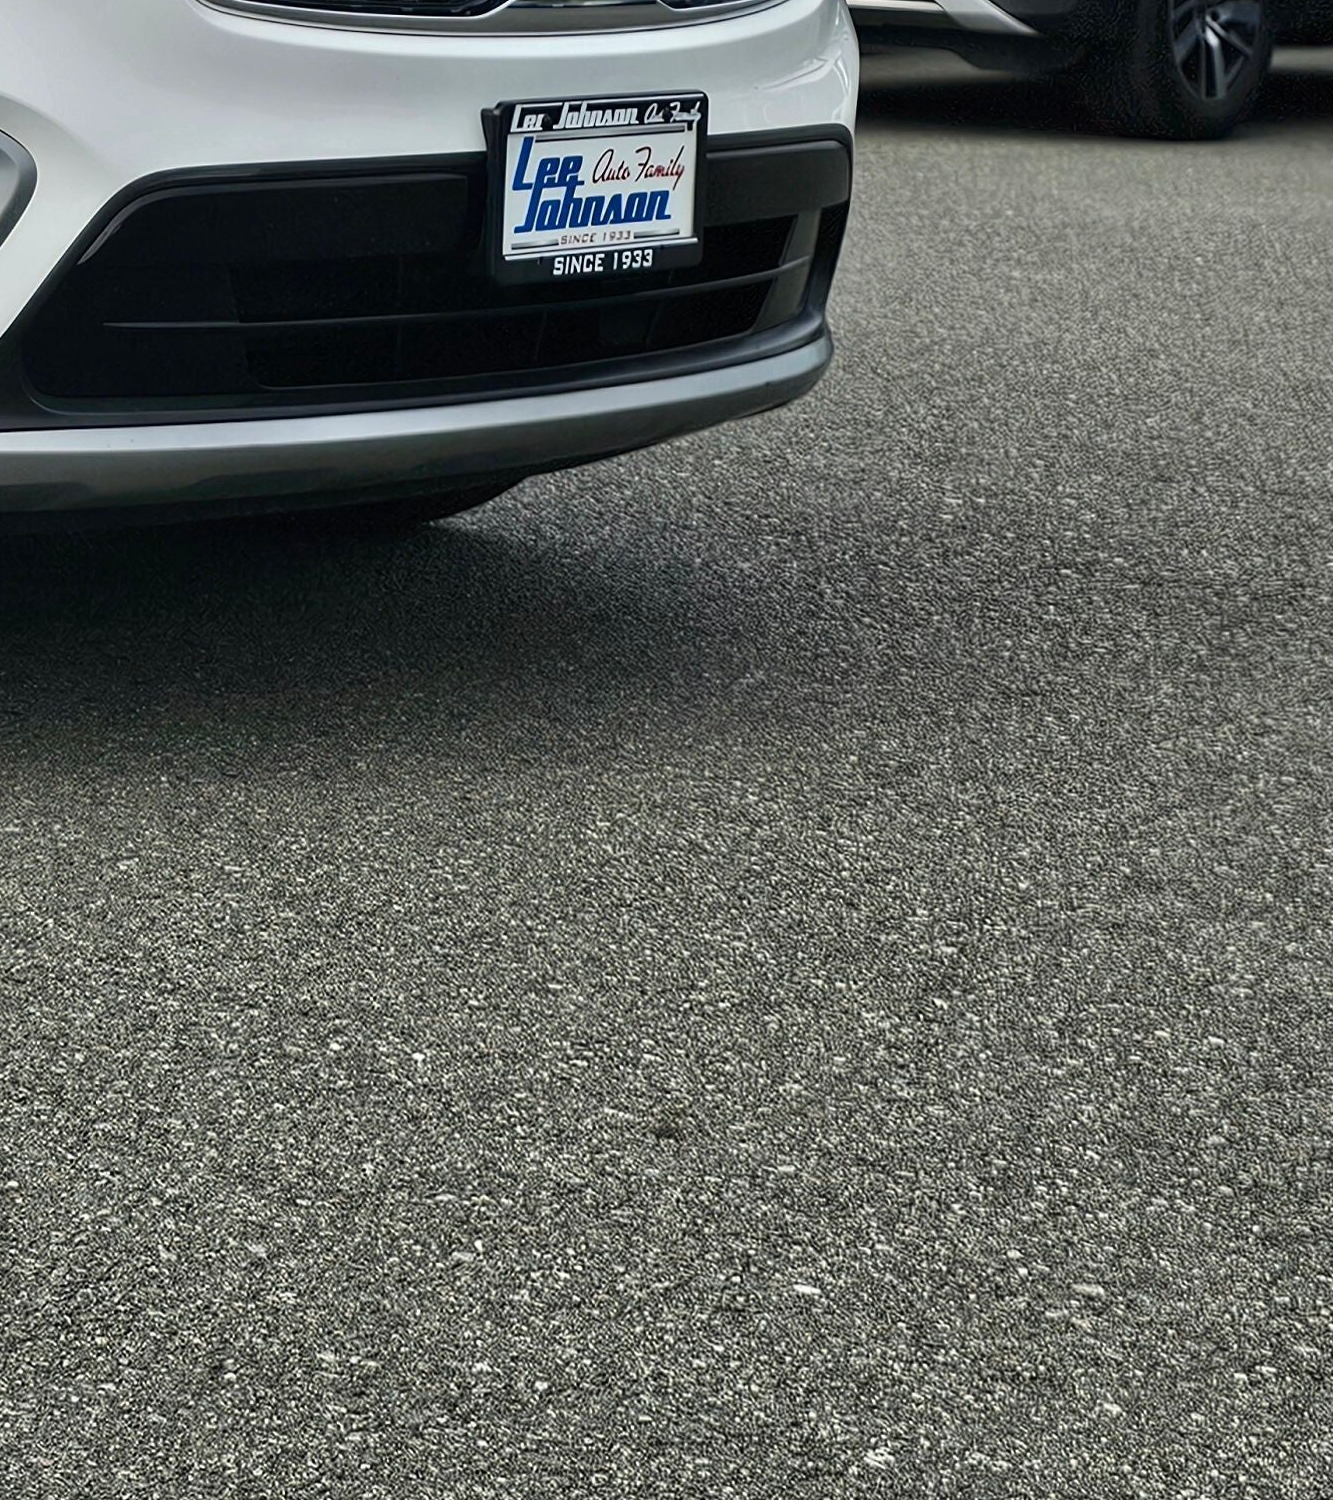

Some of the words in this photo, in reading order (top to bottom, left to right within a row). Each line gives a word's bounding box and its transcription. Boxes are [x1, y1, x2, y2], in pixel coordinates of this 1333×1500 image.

[553, 100, 640, 131] Johnson
[511, 136, 585, 191] Lee
[592, 148, 631, 184] Auto
[635, 145, 685, 190] Family
[514, 184, 672, 234] Johnson
[560, 232, 598, 246] SINCE
[602, 229, 632, 242] 1933
[553, 253, 604, 276] SINCE
[613, 249, 654, 270] 1933
